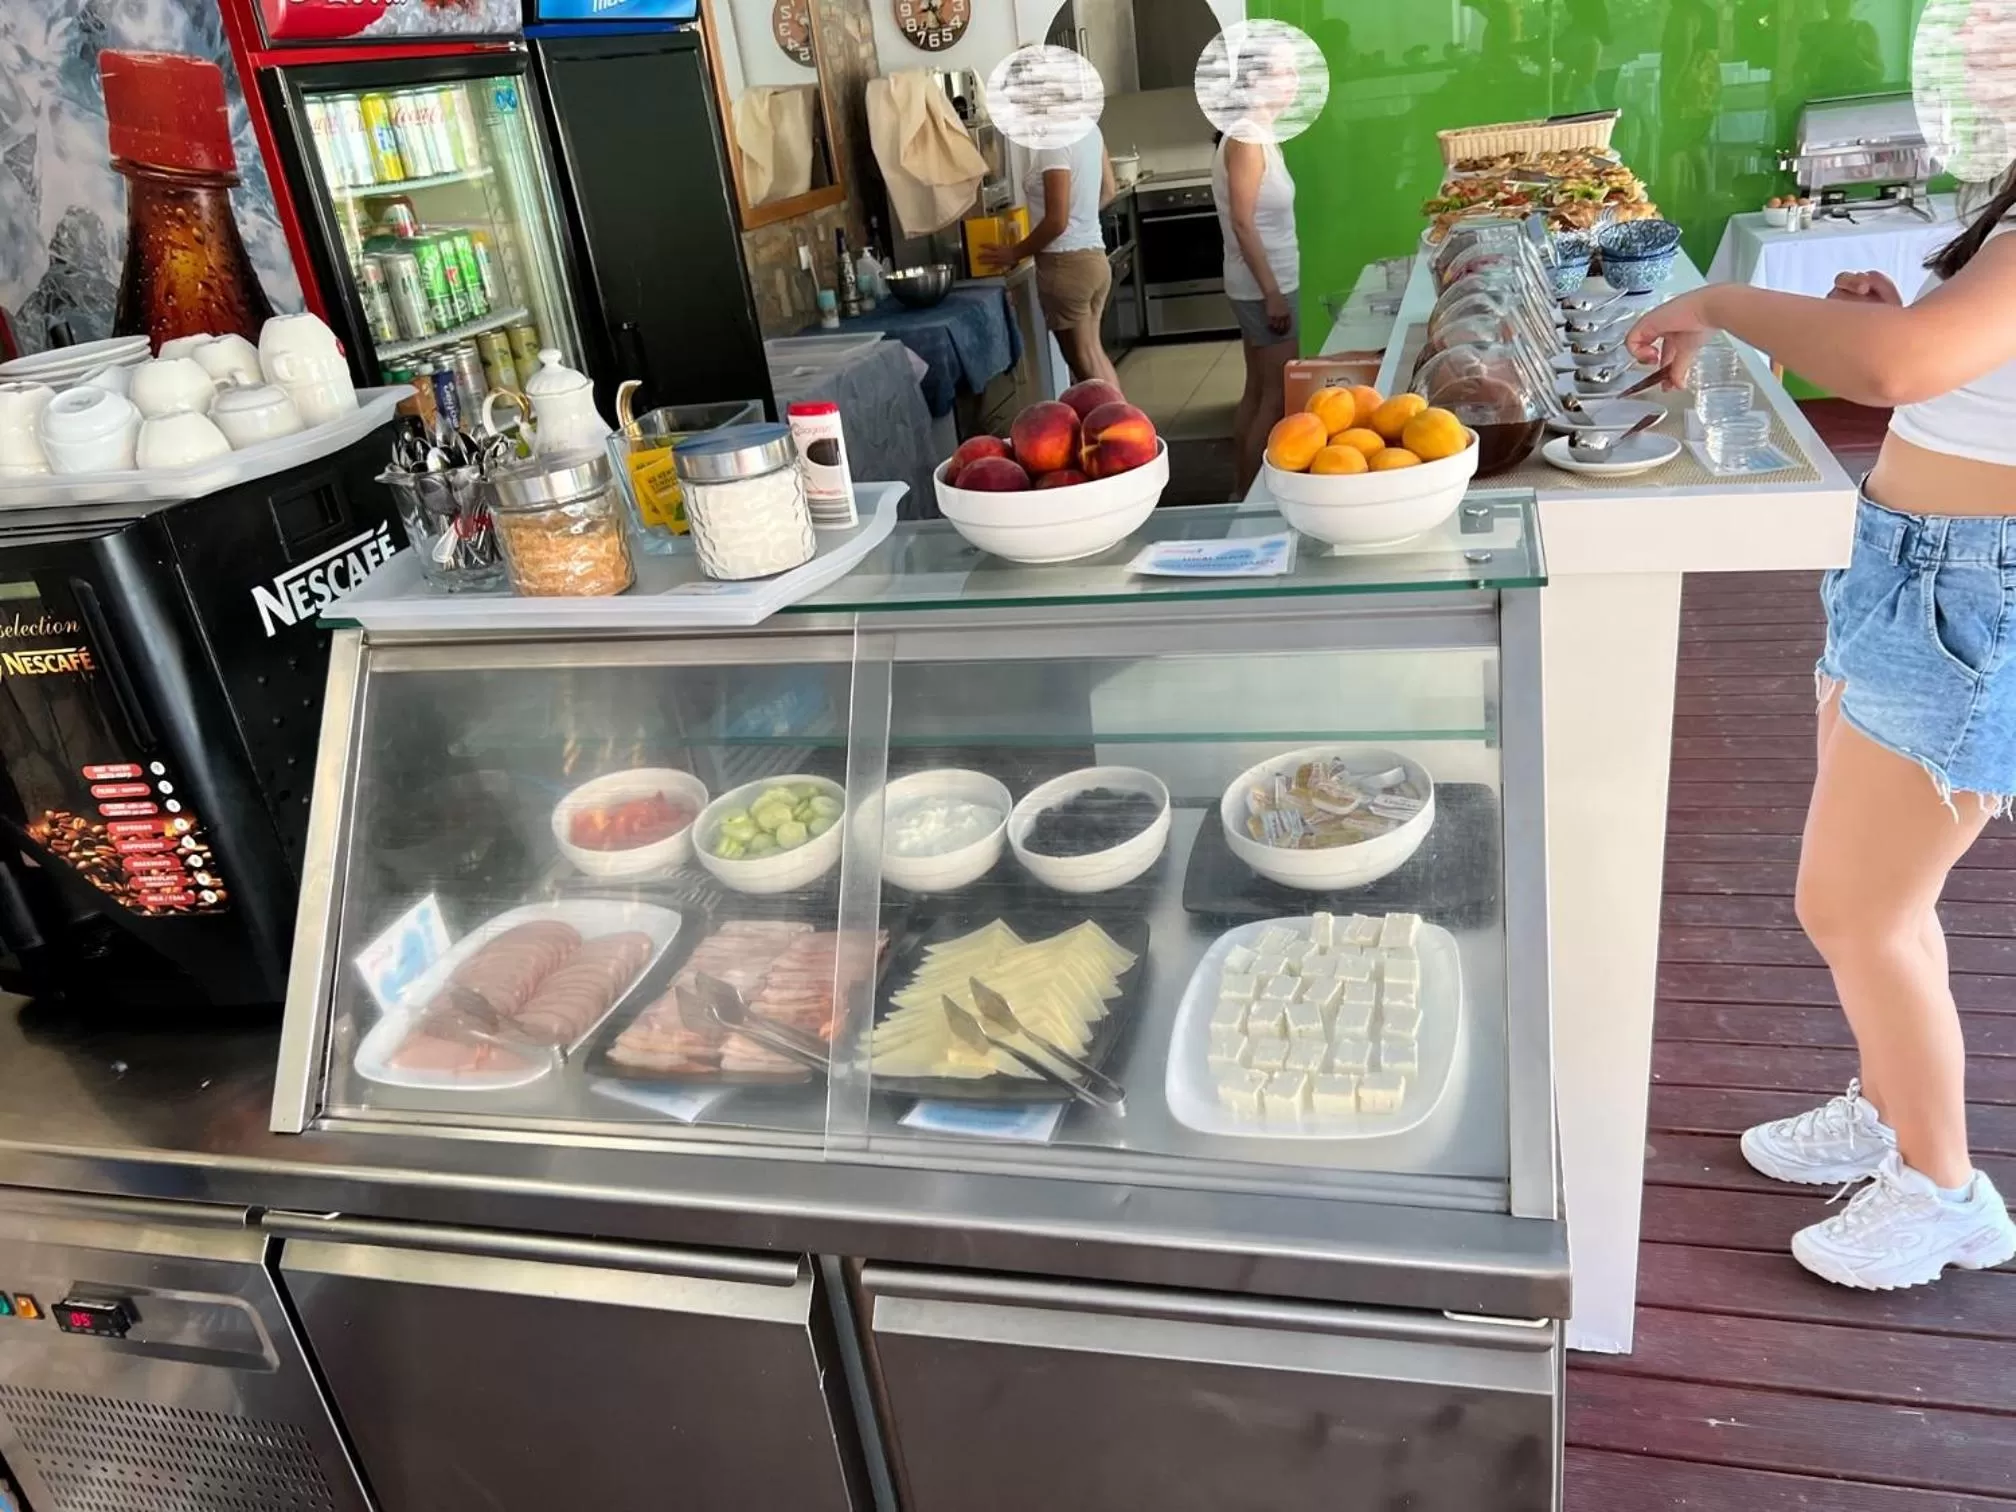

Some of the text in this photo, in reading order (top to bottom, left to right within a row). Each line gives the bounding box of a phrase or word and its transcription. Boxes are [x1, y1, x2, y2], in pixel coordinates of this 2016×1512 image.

[900, 3, 911, 17] 9
[905, 18, 917, 33] 8
[949, 15, 963, 29] 4
[917, 31, 926, 46] 7
[929, 33, 940, 48] 6
[941, 27, 953, 42] 5
[250, 519, 397, 638] NESCAFÉ
[0, 611, 80, 639] selection
[1, 645, 95, 676] NESCAFÉ
